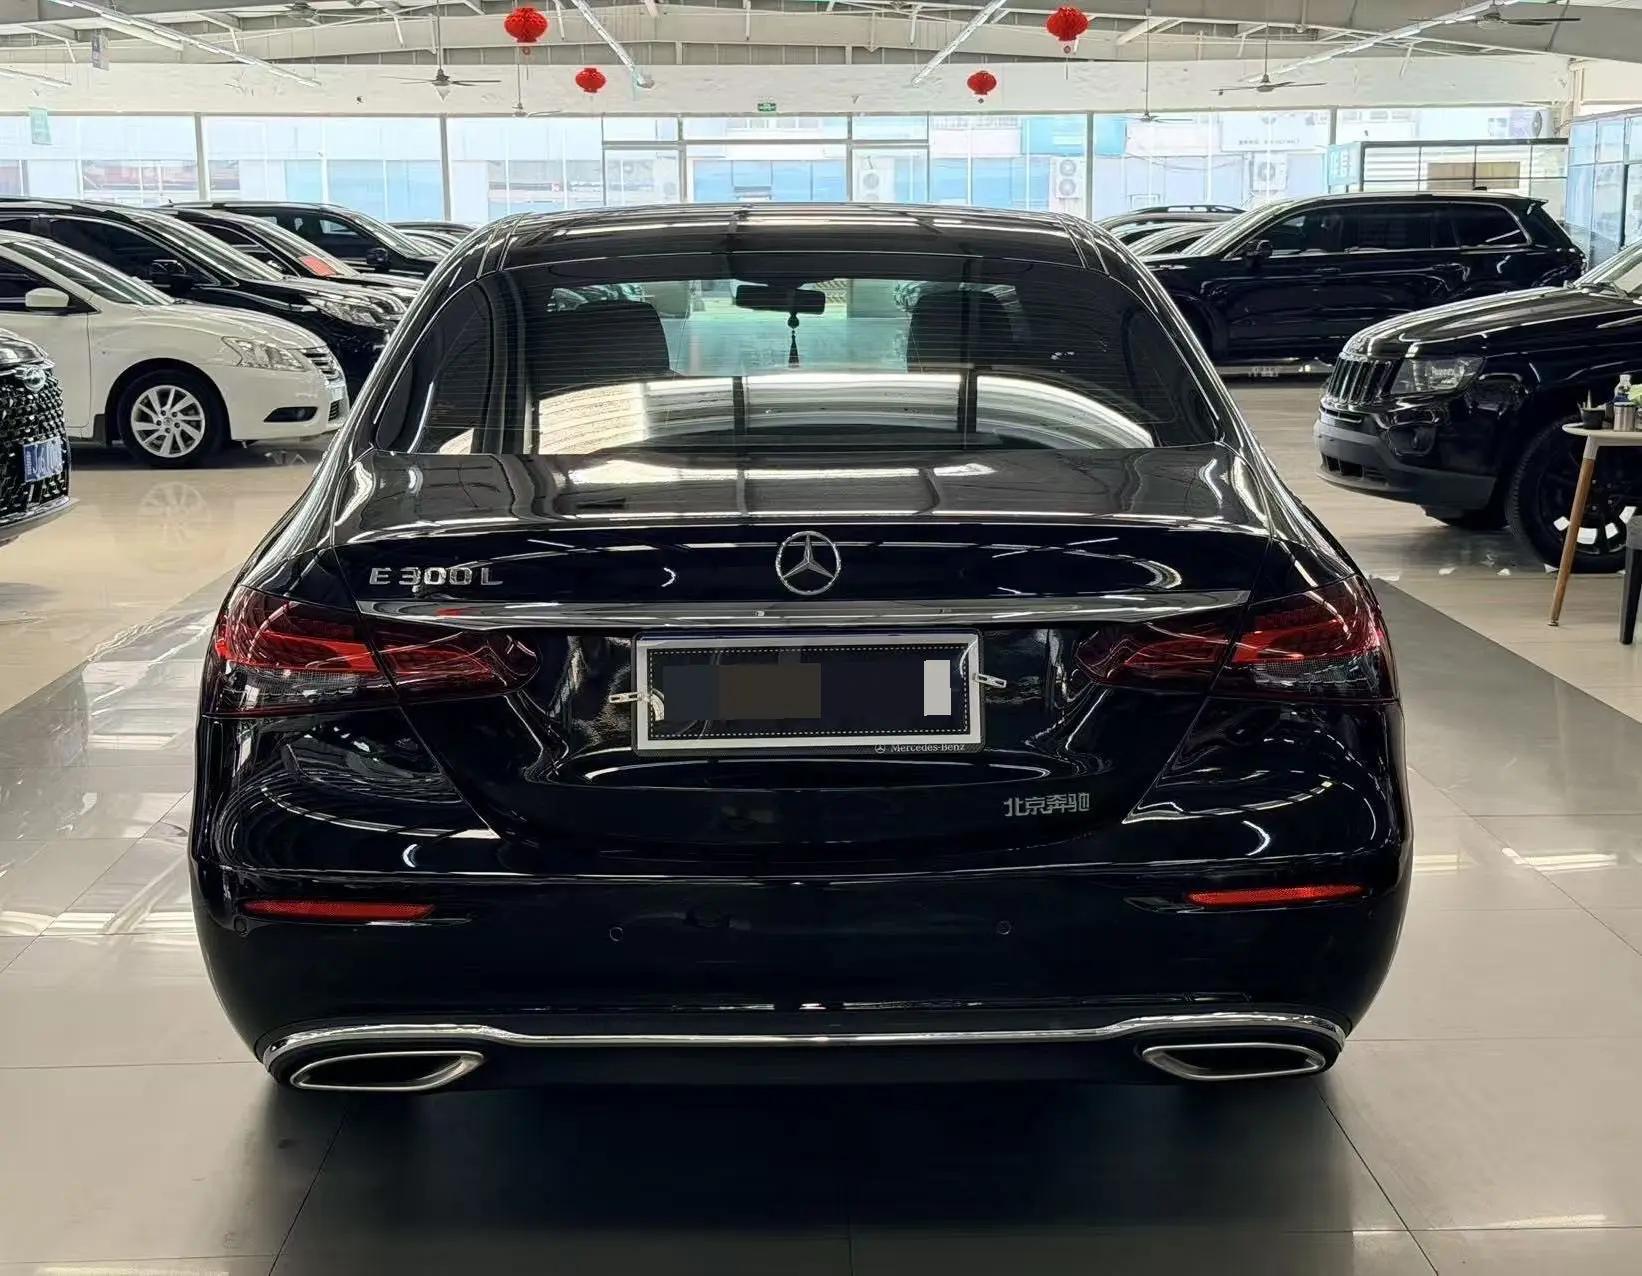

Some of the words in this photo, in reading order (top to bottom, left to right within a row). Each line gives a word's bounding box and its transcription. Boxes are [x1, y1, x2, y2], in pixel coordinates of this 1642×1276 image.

[369, 567, 392, 585] E
[890, 743, 965, 753] Mercedes-Benz
[1003, 792, 1090, 817] 北京奔驰
